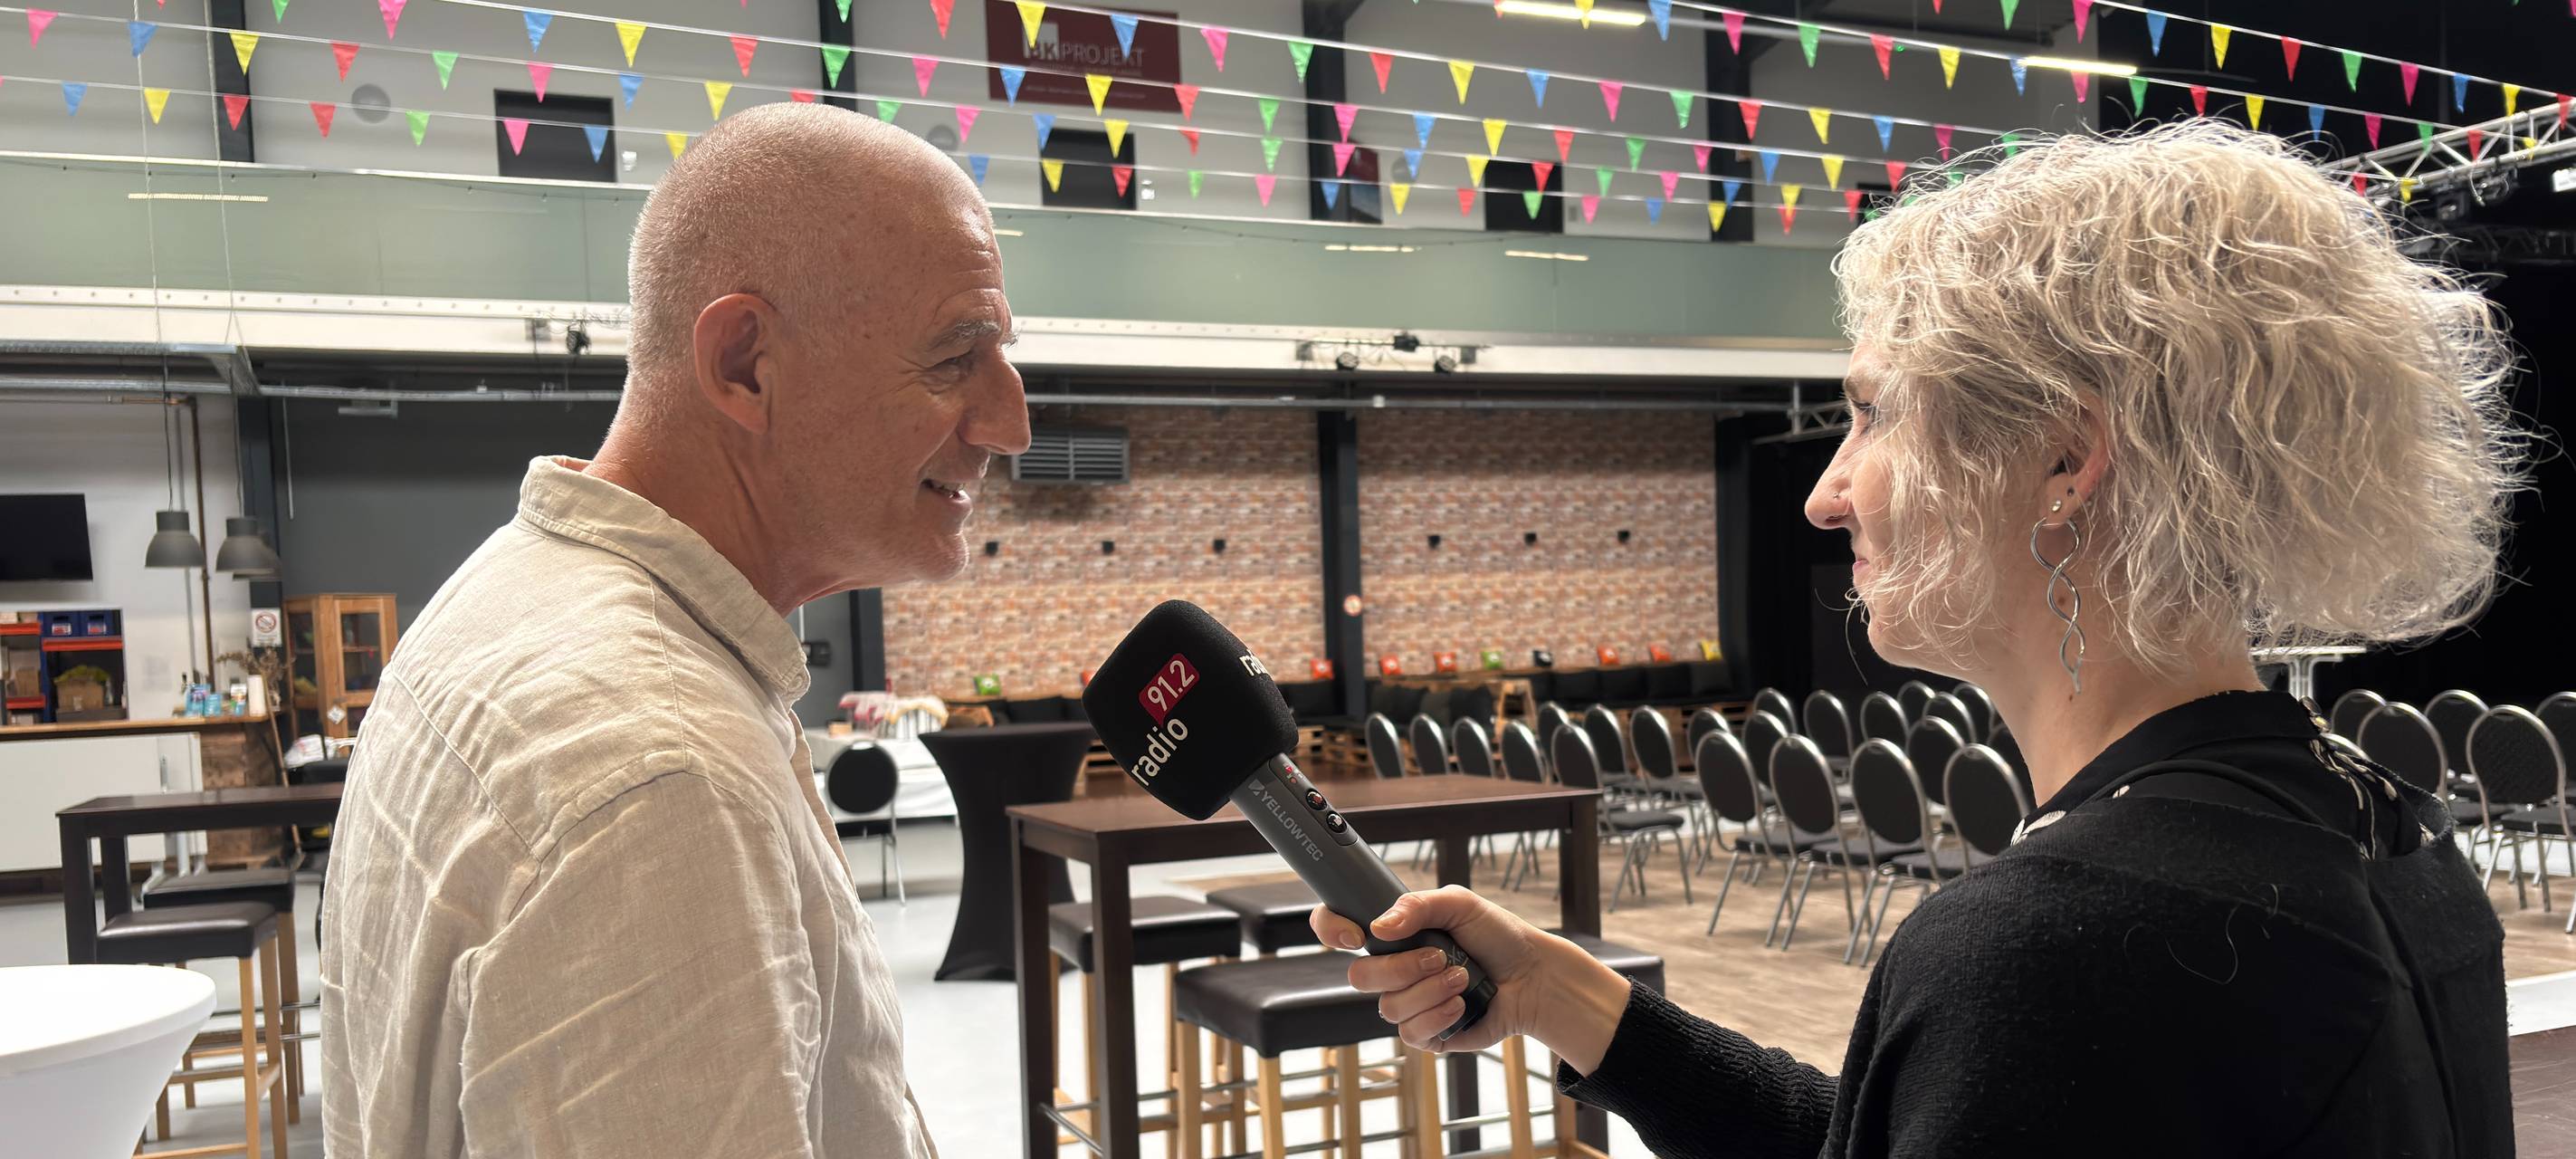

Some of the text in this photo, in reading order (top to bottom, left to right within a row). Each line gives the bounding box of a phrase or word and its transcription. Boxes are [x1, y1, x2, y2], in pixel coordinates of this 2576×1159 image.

[1147, 660, 1195, 712] 91.2
[1131, 718, 1188, 787] radio
[1261, 790, 1323, 861] YELLOWTEC
